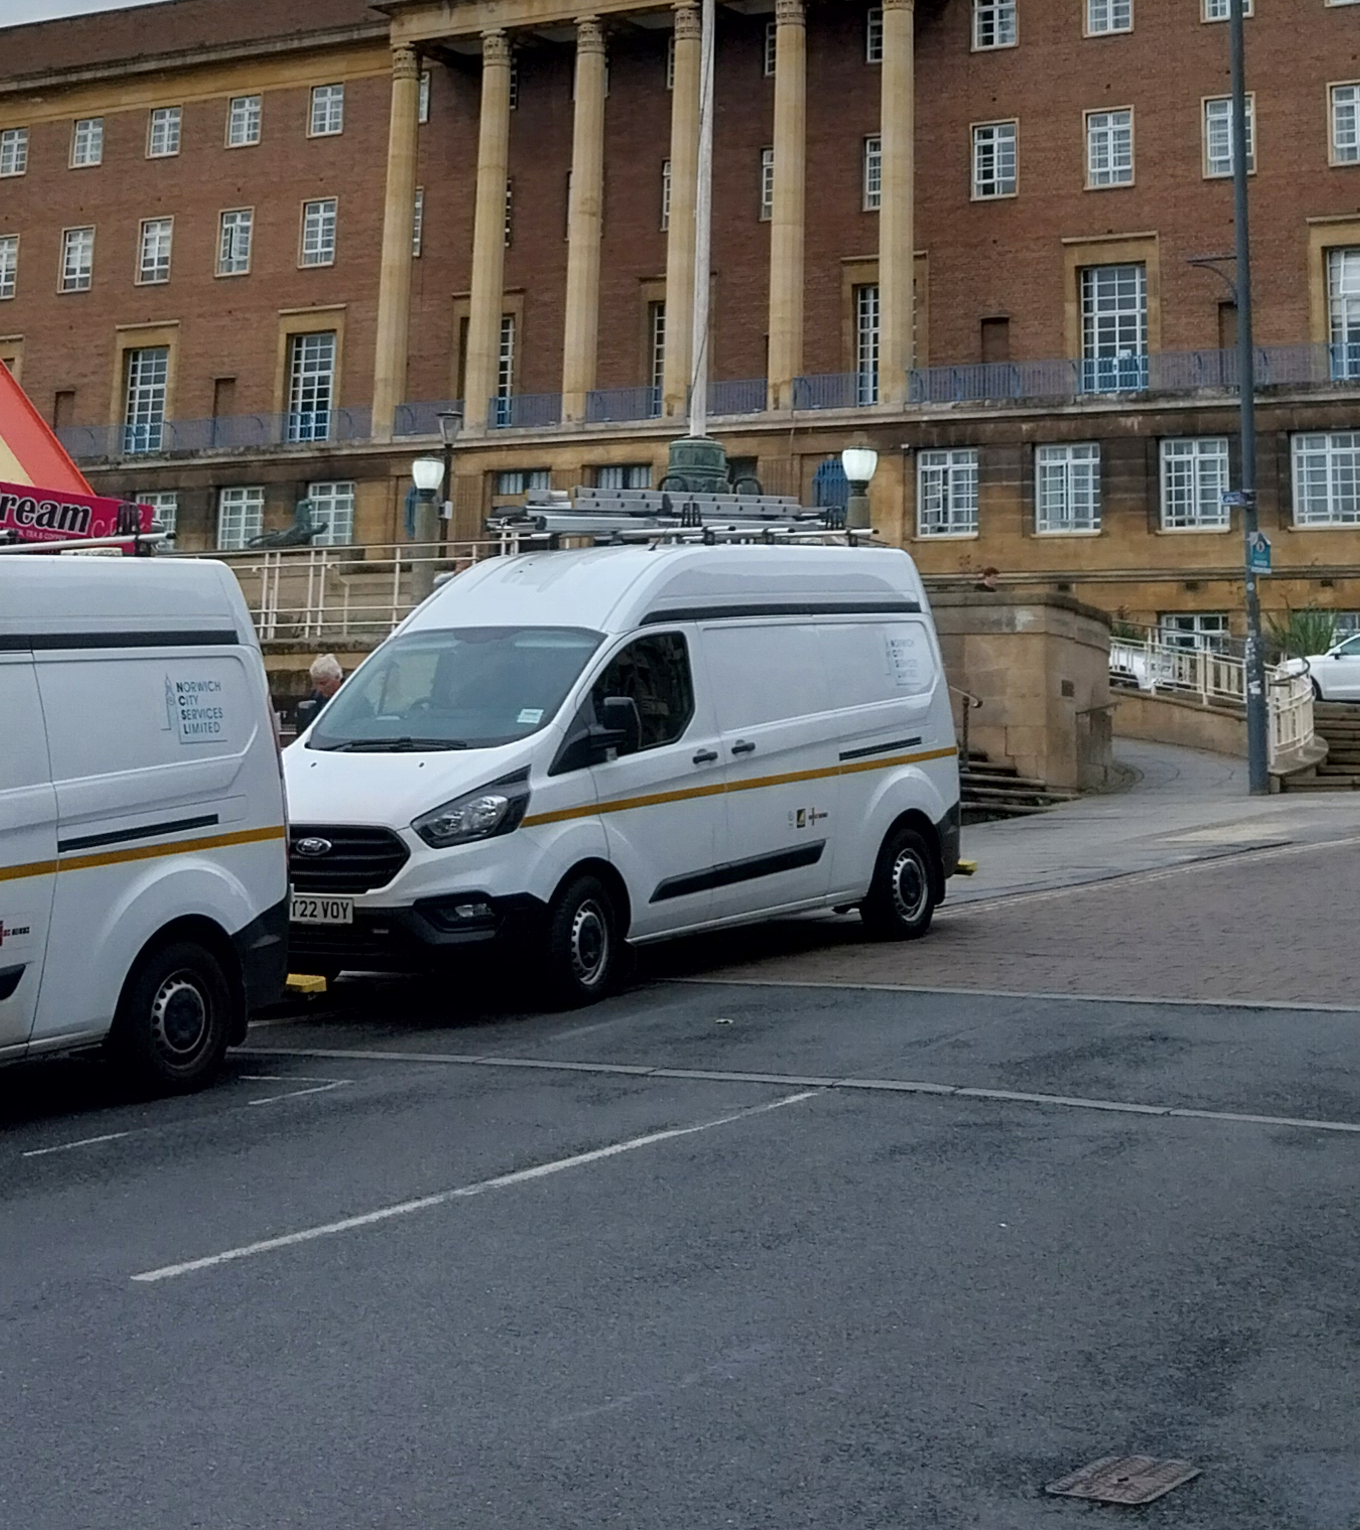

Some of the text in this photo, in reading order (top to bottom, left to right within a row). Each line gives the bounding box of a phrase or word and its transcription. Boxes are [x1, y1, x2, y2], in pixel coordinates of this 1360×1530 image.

[176, 680, 222, 693] NORWICH
[178, 695, 199, 706] CITY
[181, 707, 224, 721] SERVICES
[183, 721, 221, 735] LIMITED
[292, 900, 349, 920] T22 VOY
